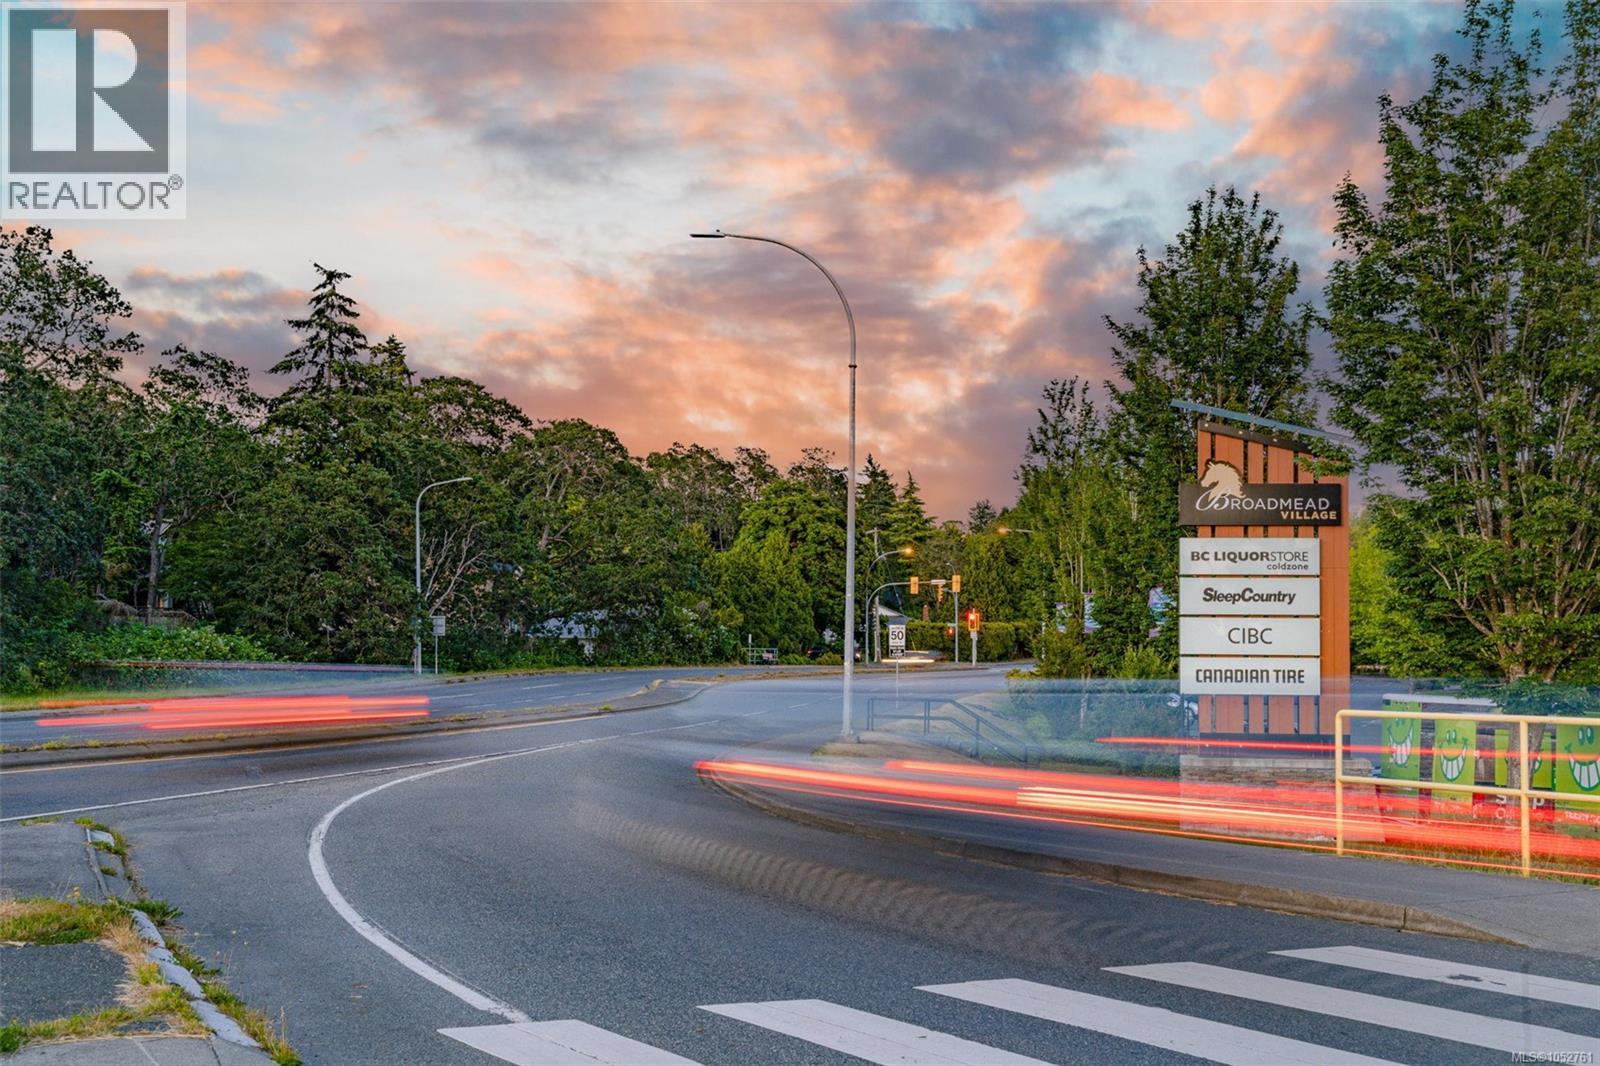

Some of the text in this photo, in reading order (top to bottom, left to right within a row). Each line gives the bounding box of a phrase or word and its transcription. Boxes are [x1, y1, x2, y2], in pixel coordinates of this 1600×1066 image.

[1195, 488, 1331, 511] BROADMEAD
[1280, 511, 1337, 520] VILLAGE
[1191, 551, 1210, 562] BC
[1266, 563, 1309, 571] coldzone
[891, 630, 904, 640] 50
[1227, 628, 1273, 645] CIBC
[1195, 669, 1305, 684] CANADIAN TIRE
